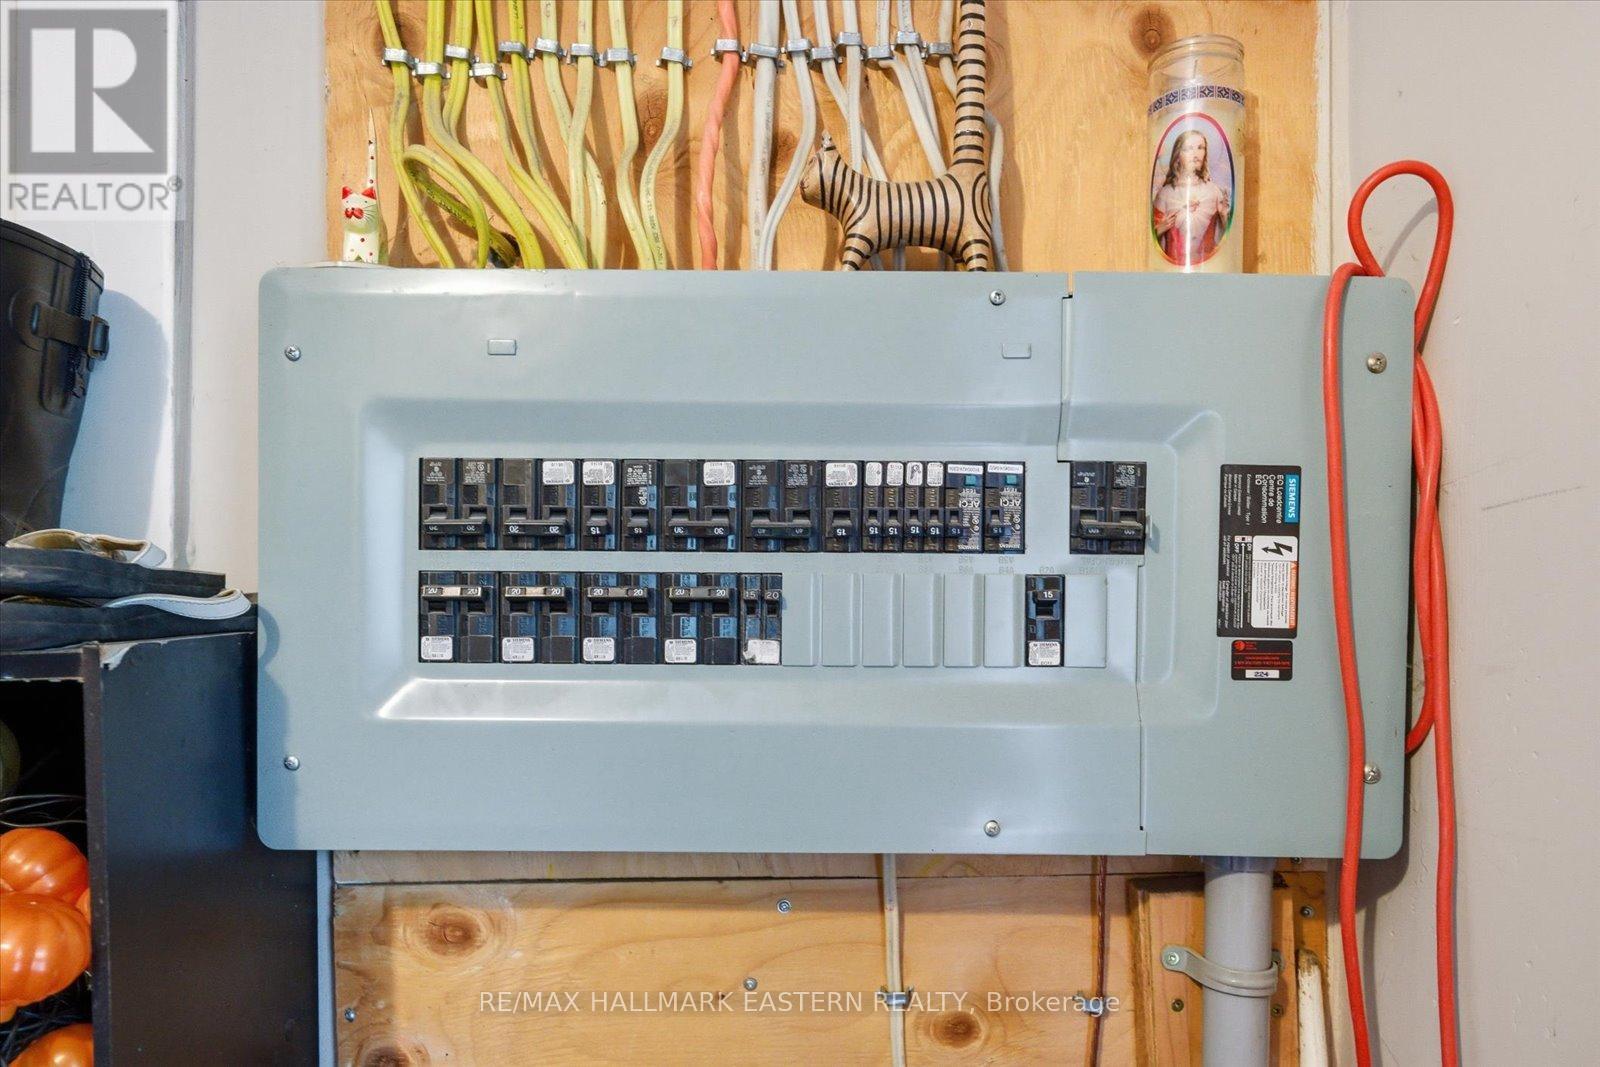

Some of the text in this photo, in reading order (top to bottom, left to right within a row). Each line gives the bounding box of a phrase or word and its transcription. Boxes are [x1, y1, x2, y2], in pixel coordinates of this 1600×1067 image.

[1261, 474, 1269, 524] Consommation
[1268, 474, 1276, 507] Centre de
[1275, 487, 1283, 524] Loadcentre
[1287, 478, 1296, 519] SIEMENS
[930, 527, 940, 535] 15
[593, 588, 603, 596] 20
